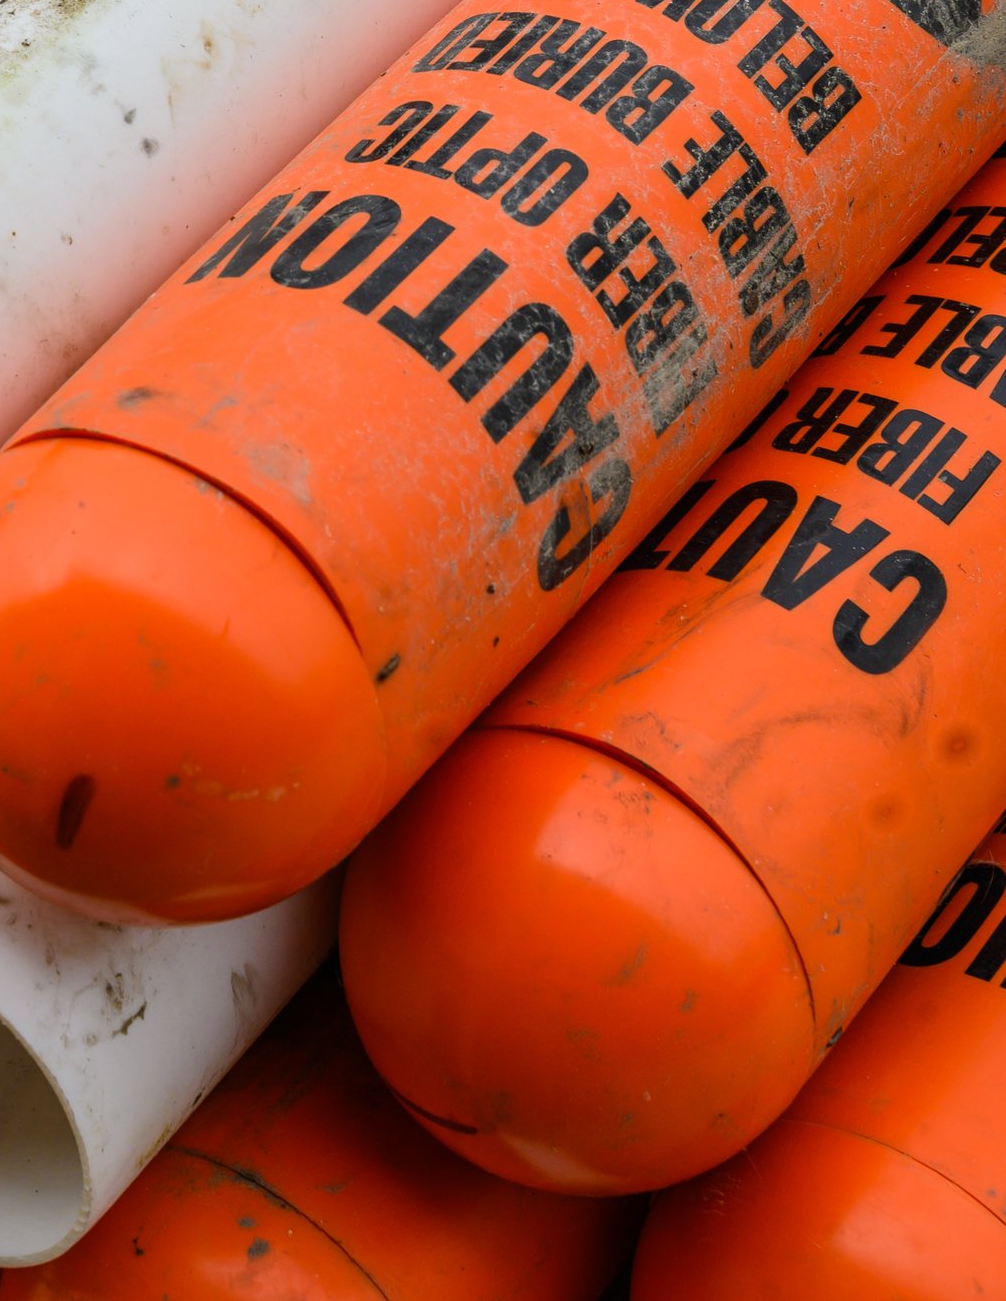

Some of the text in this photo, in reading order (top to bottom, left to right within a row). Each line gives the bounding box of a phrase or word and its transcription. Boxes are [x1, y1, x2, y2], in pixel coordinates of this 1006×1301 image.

[345, 100, 590, 227] OPTIC
[411, 11, 812, 369] CABLE BURIED
[183, 190, 632, 591] CAUTION
[772, 387, 1002, 526] FIBER
[615, 479, 947, 675] CAUT
